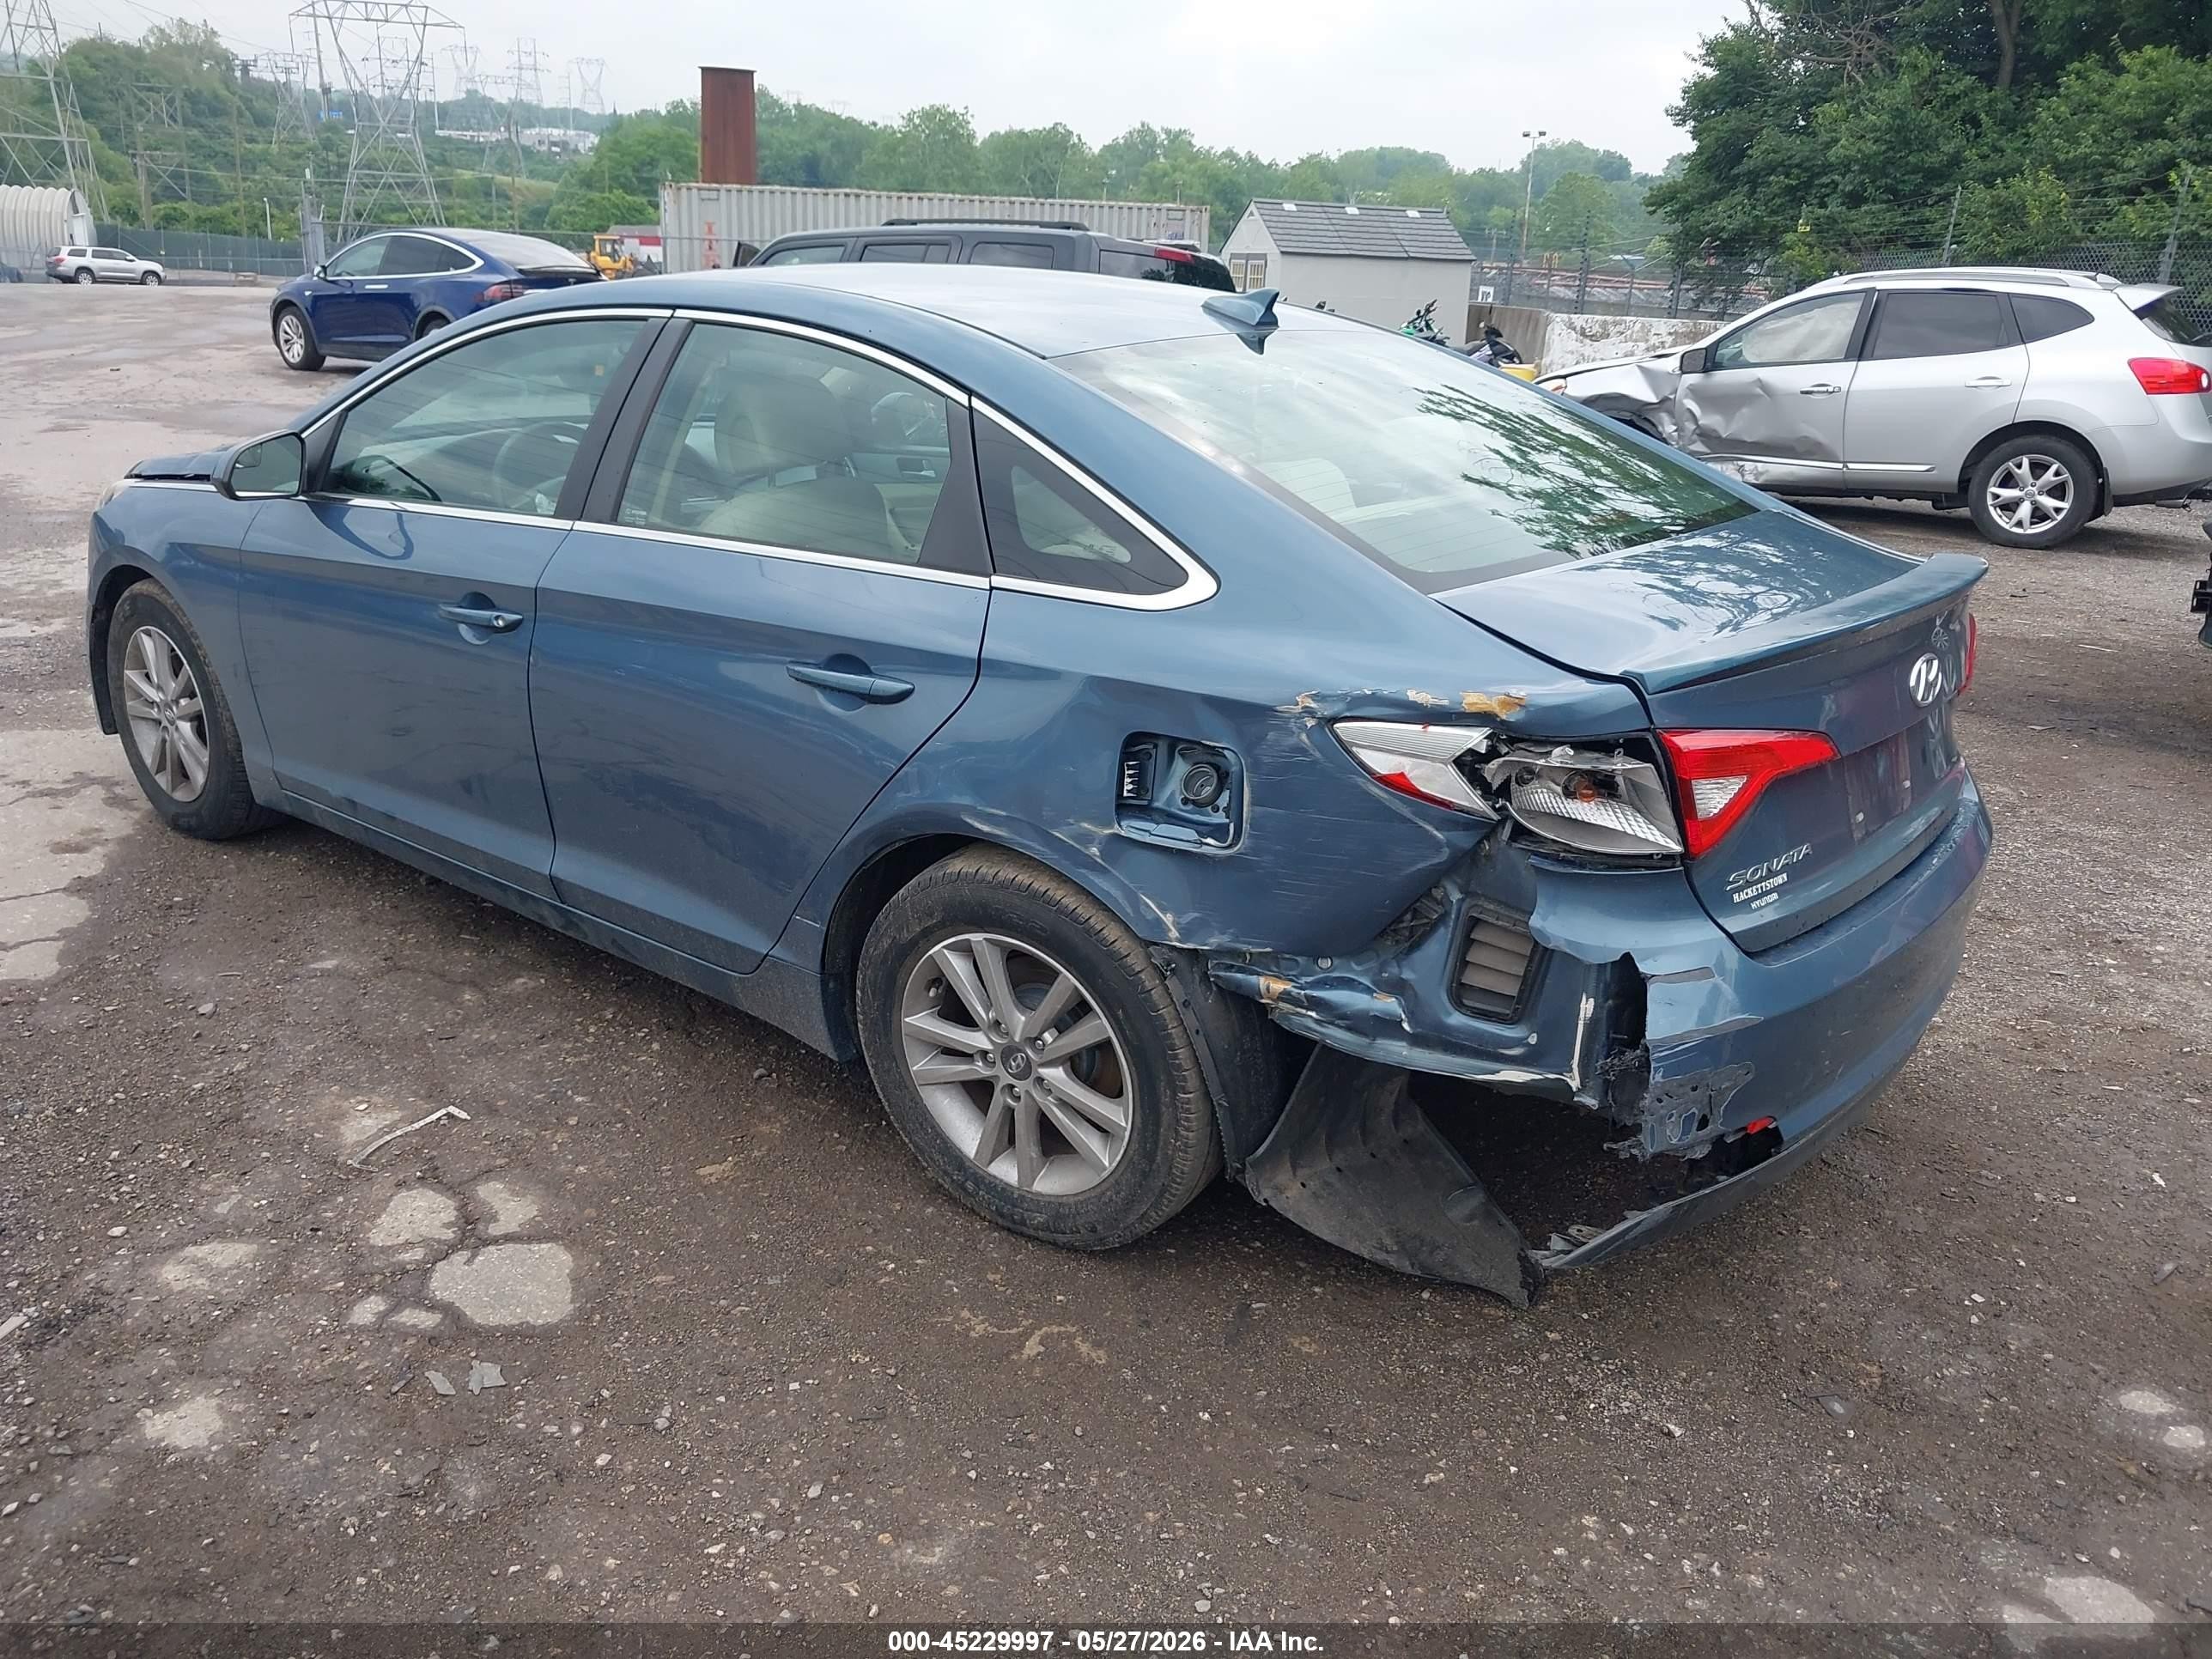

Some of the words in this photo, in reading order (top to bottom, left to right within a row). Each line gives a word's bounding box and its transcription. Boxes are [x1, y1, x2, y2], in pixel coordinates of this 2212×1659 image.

[1724, 843, 1813, 890] SONATA
[1733, 872, 1788, 902] HACKETTSTOWN
[1750, 892, 1779, 909] HYUNDAI
